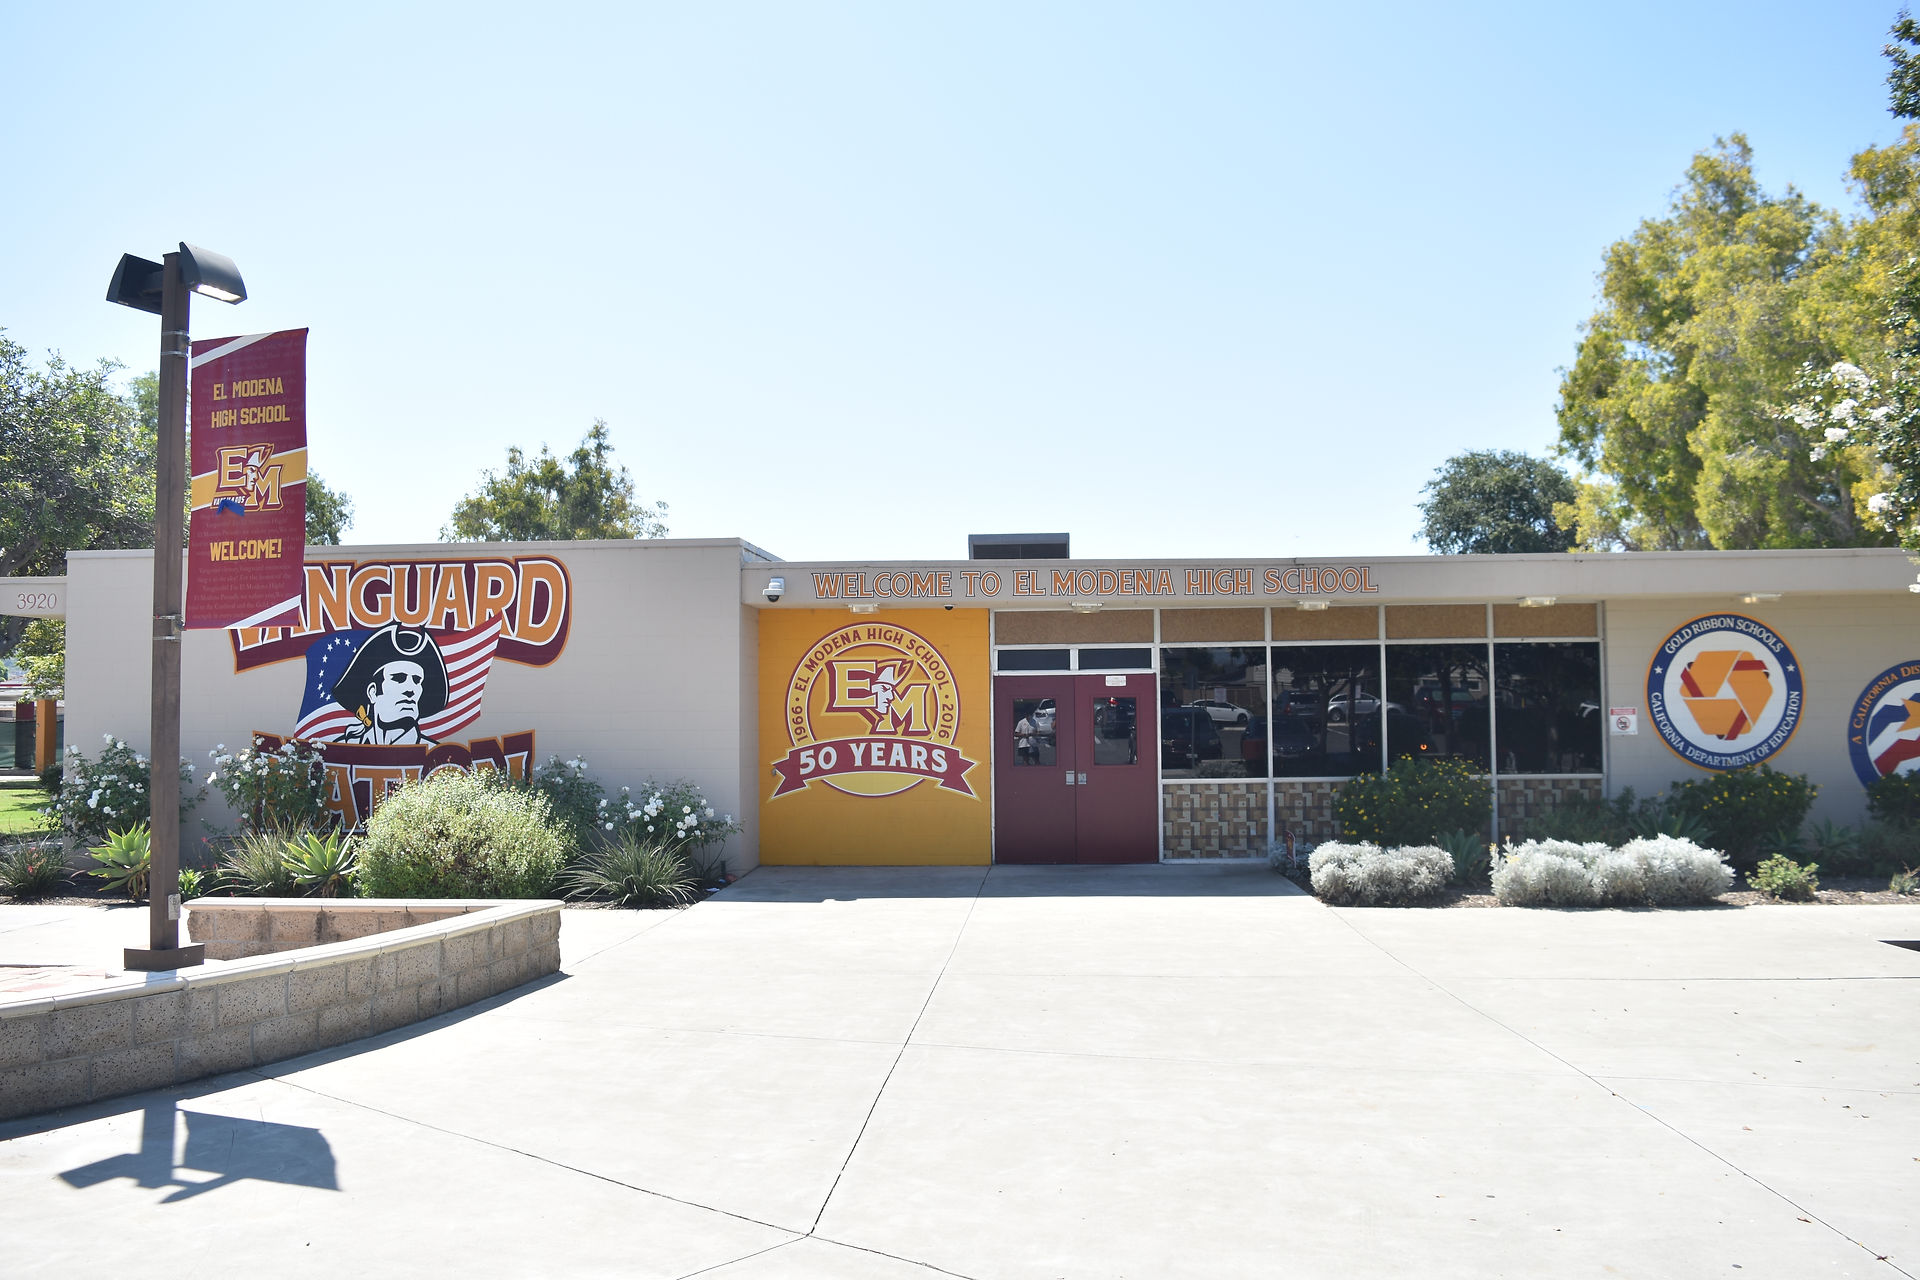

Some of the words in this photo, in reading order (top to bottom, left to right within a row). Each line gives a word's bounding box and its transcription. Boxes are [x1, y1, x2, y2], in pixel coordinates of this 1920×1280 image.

[213, 383, 227, 401] EL
[232, 377, 284, 398] MODENA
[211, 409, 237, 428] HIGH
[240, 404, 291, 425] SCHOOL
[210, 538, 282, 562] WELCOME!
[812, 571, 952, 599] WELCOME
[960, 571, 1002, 598] TO
[1012, 570, 1046, 598] EL
[1050, 569, 1175, 597] MODENA
[1184, 568, 1254, 596] HIGH
[1264, 567, 1378, 595] SCHOOL
[17, 593, 57, 609] 3920
[239, 560, 567, 650] NGUARD
[1664, 628, 1693, 654] GOLD
[1691, 617, 1735, 635] RIBBON
[1735, 619, 1784, 653] SCHOOLS
[794, 674, 810, 692] EL
[804, 629, 862, 674] MODENA
[867, 628, 904, 644] HIGH
[906, 639, 949, 691] SCHOOL
[1853, 672, 1899, 729] CALIFORNIA
[791, 706, 808, 742] 1966
[938, 703, 954, 739] 2016
[1651, 692, 1684, 751] CALIFORNIA
[1685, 746, 1756, 767] DEPARTMENT
[1756, 742, 1770, 757] OF
[1770, 691, 1801, 748] EDUCATION
[1852, 735, 1863, 745] A
[800, 746, 837, 775] 50
[848, 742, 948, 774] YEARS
